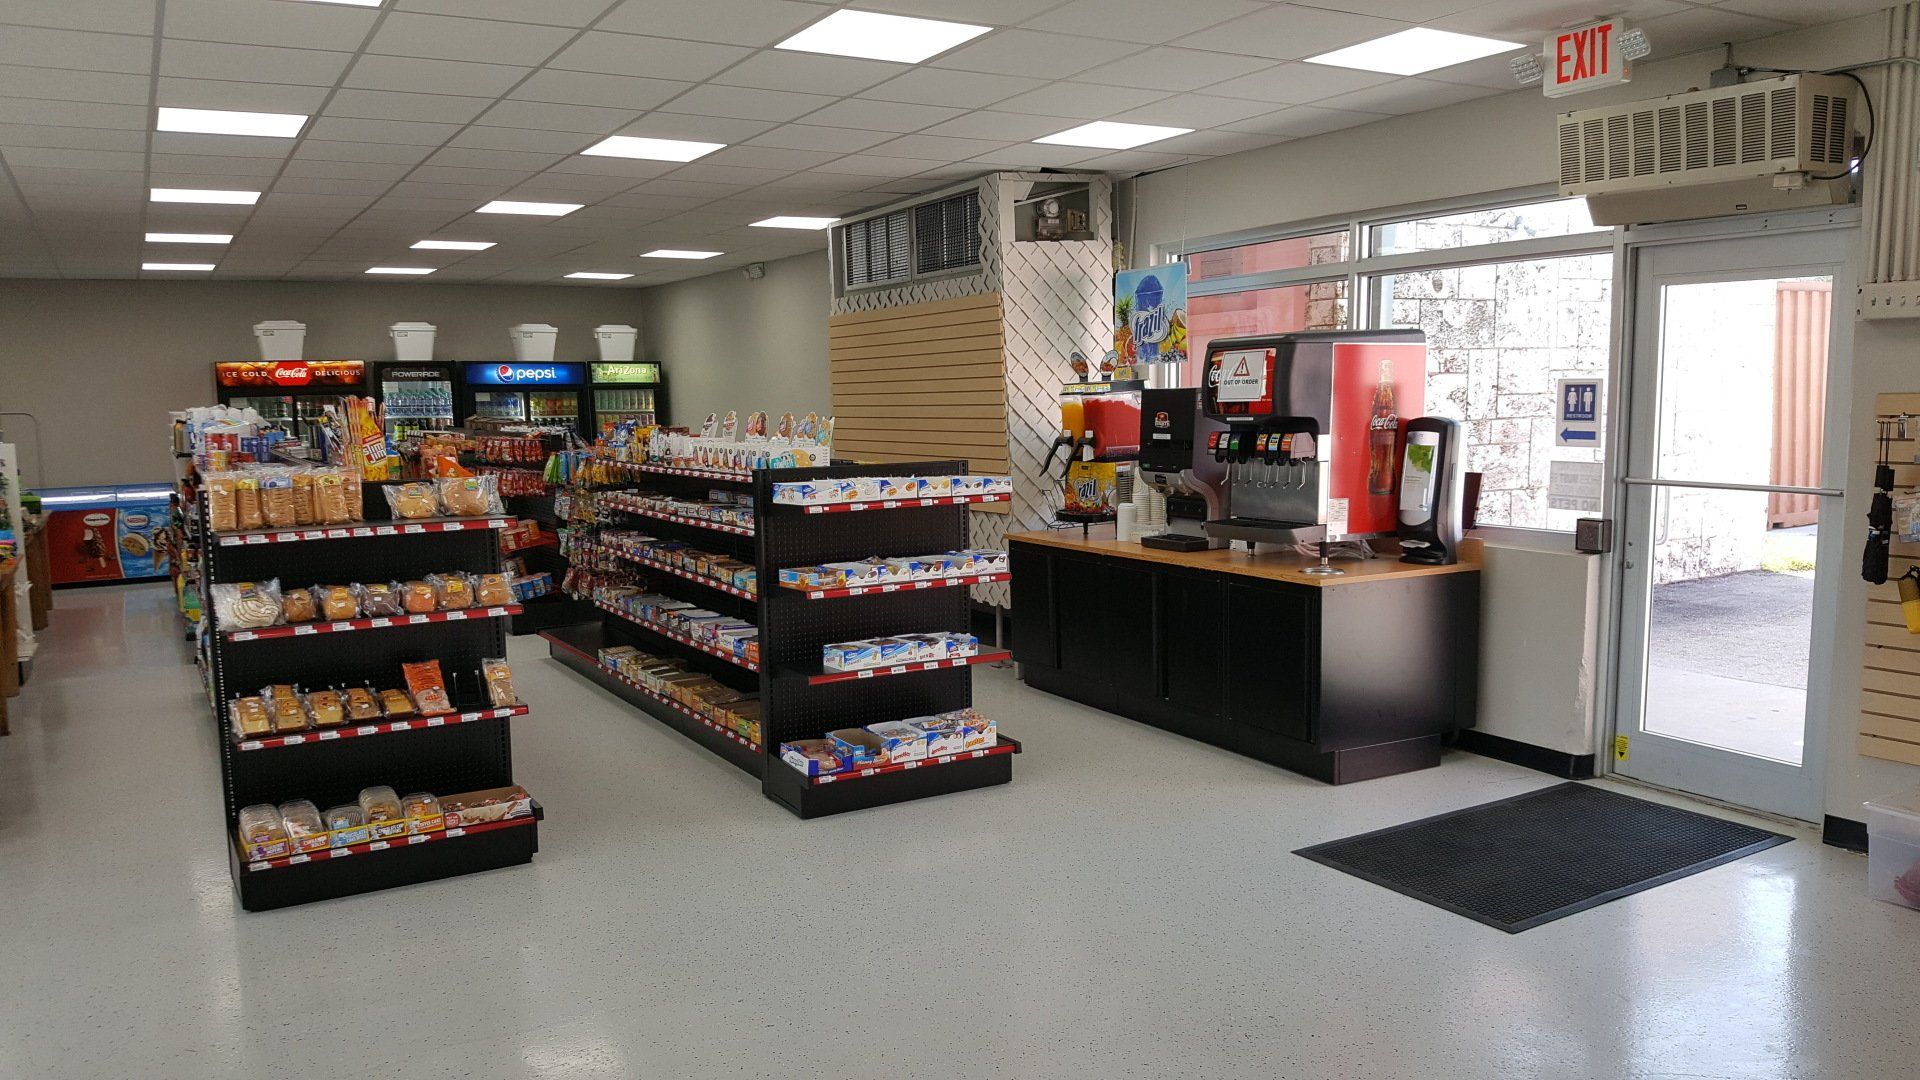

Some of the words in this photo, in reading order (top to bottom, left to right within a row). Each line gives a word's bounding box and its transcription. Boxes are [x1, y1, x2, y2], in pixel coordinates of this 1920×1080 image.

[1557, 24, 1612, 84] EXIT
[275, 368, 308, 379] Coca-Cola
[516, 367, 555, 382] pepsi
[607, 365, 647, 375] AriZona
